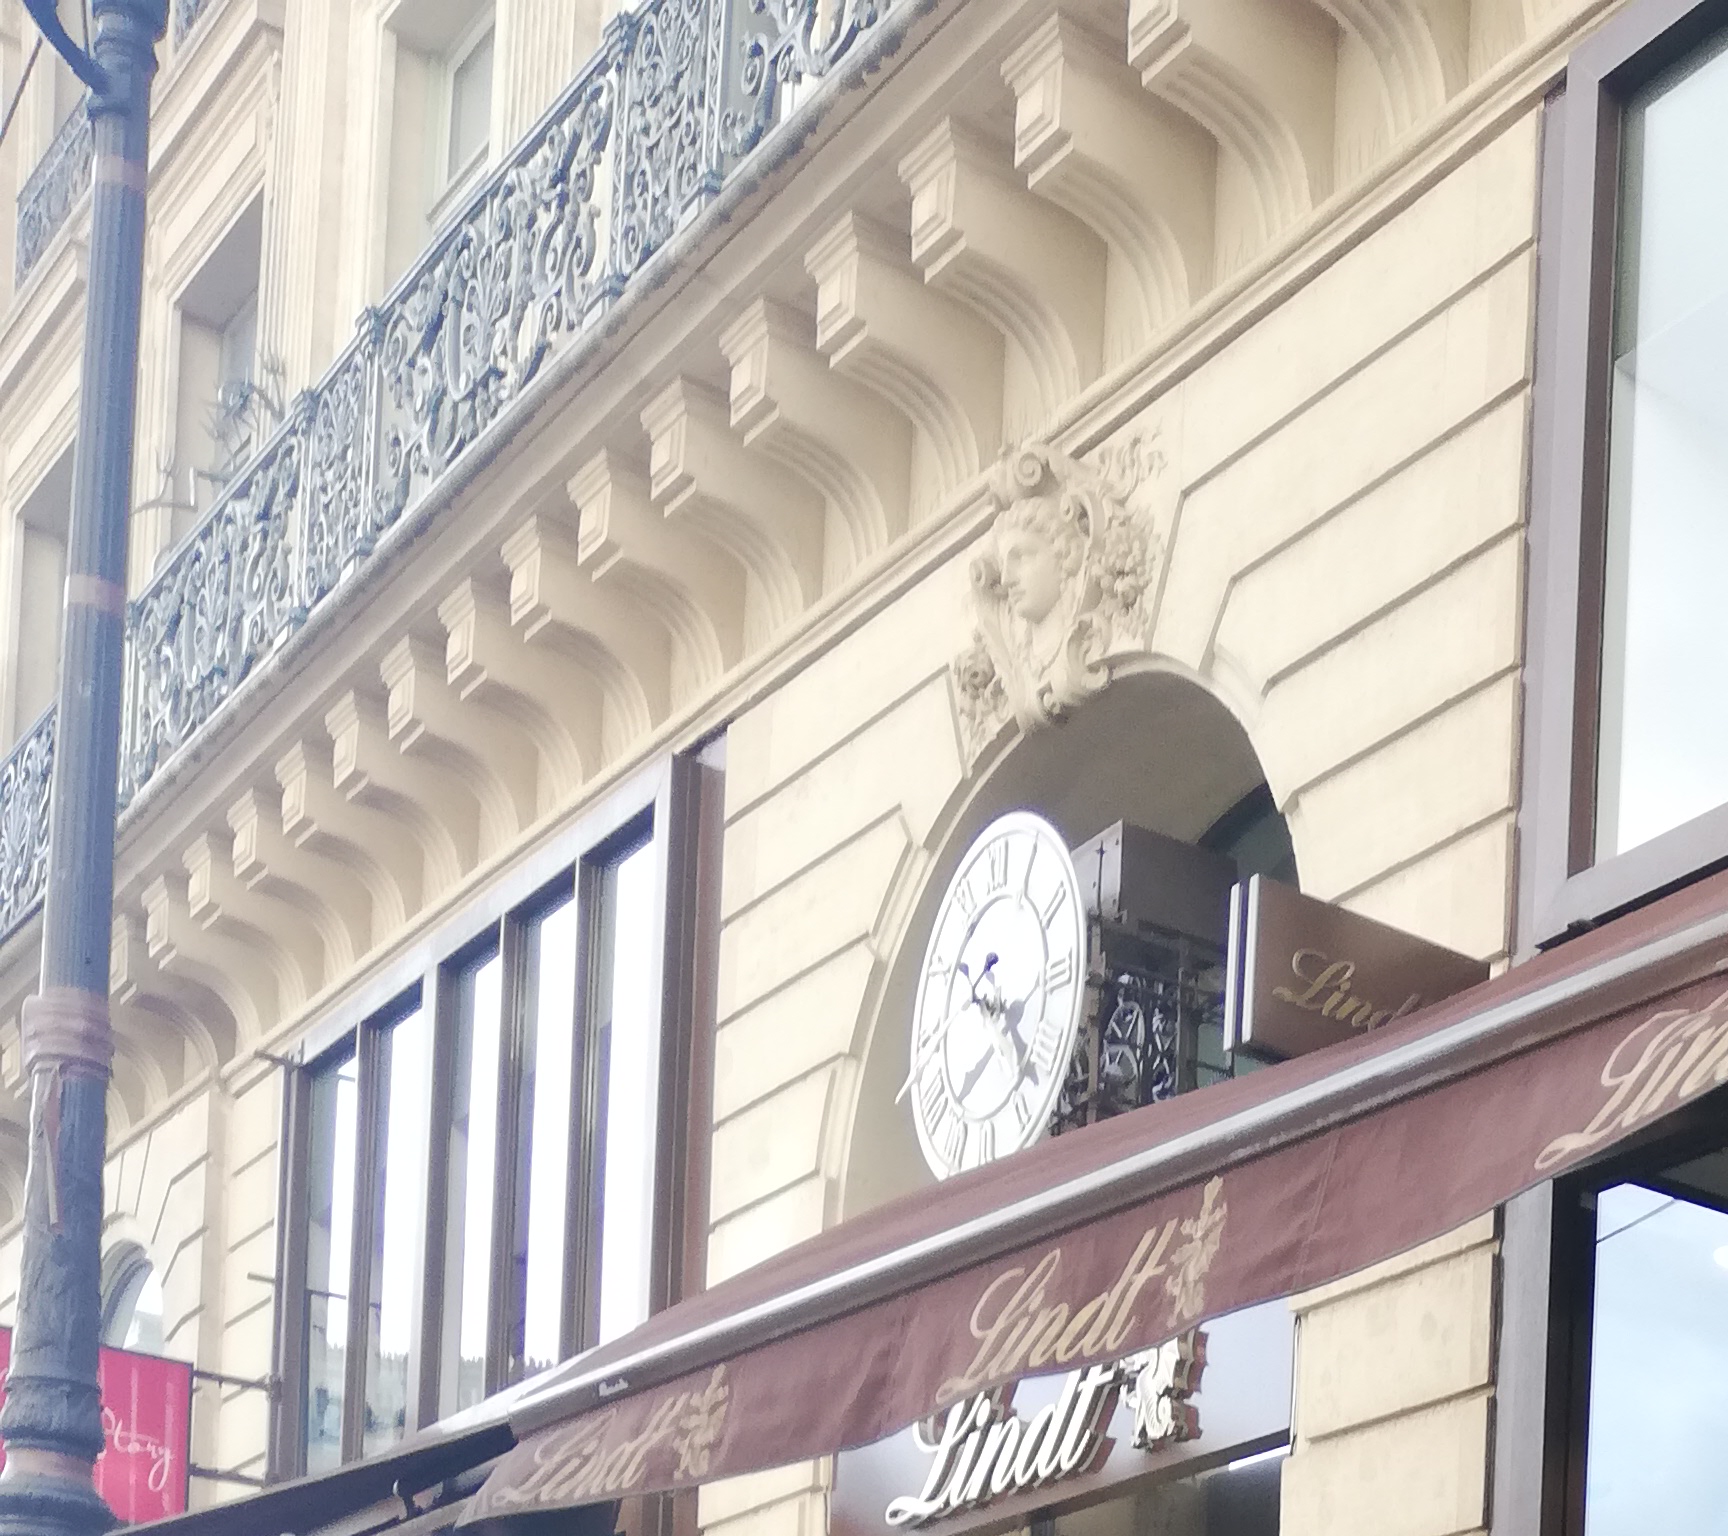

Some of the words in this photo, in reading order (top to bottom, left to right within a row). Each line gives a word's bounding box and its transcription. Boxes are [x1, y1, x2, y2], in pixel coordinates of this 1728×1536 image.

[936, 1219, 1175, 1403] Lindt
[492, 1392, 690, 1504] Lindt
[885, 1364, 1116, 1526] Lindt
